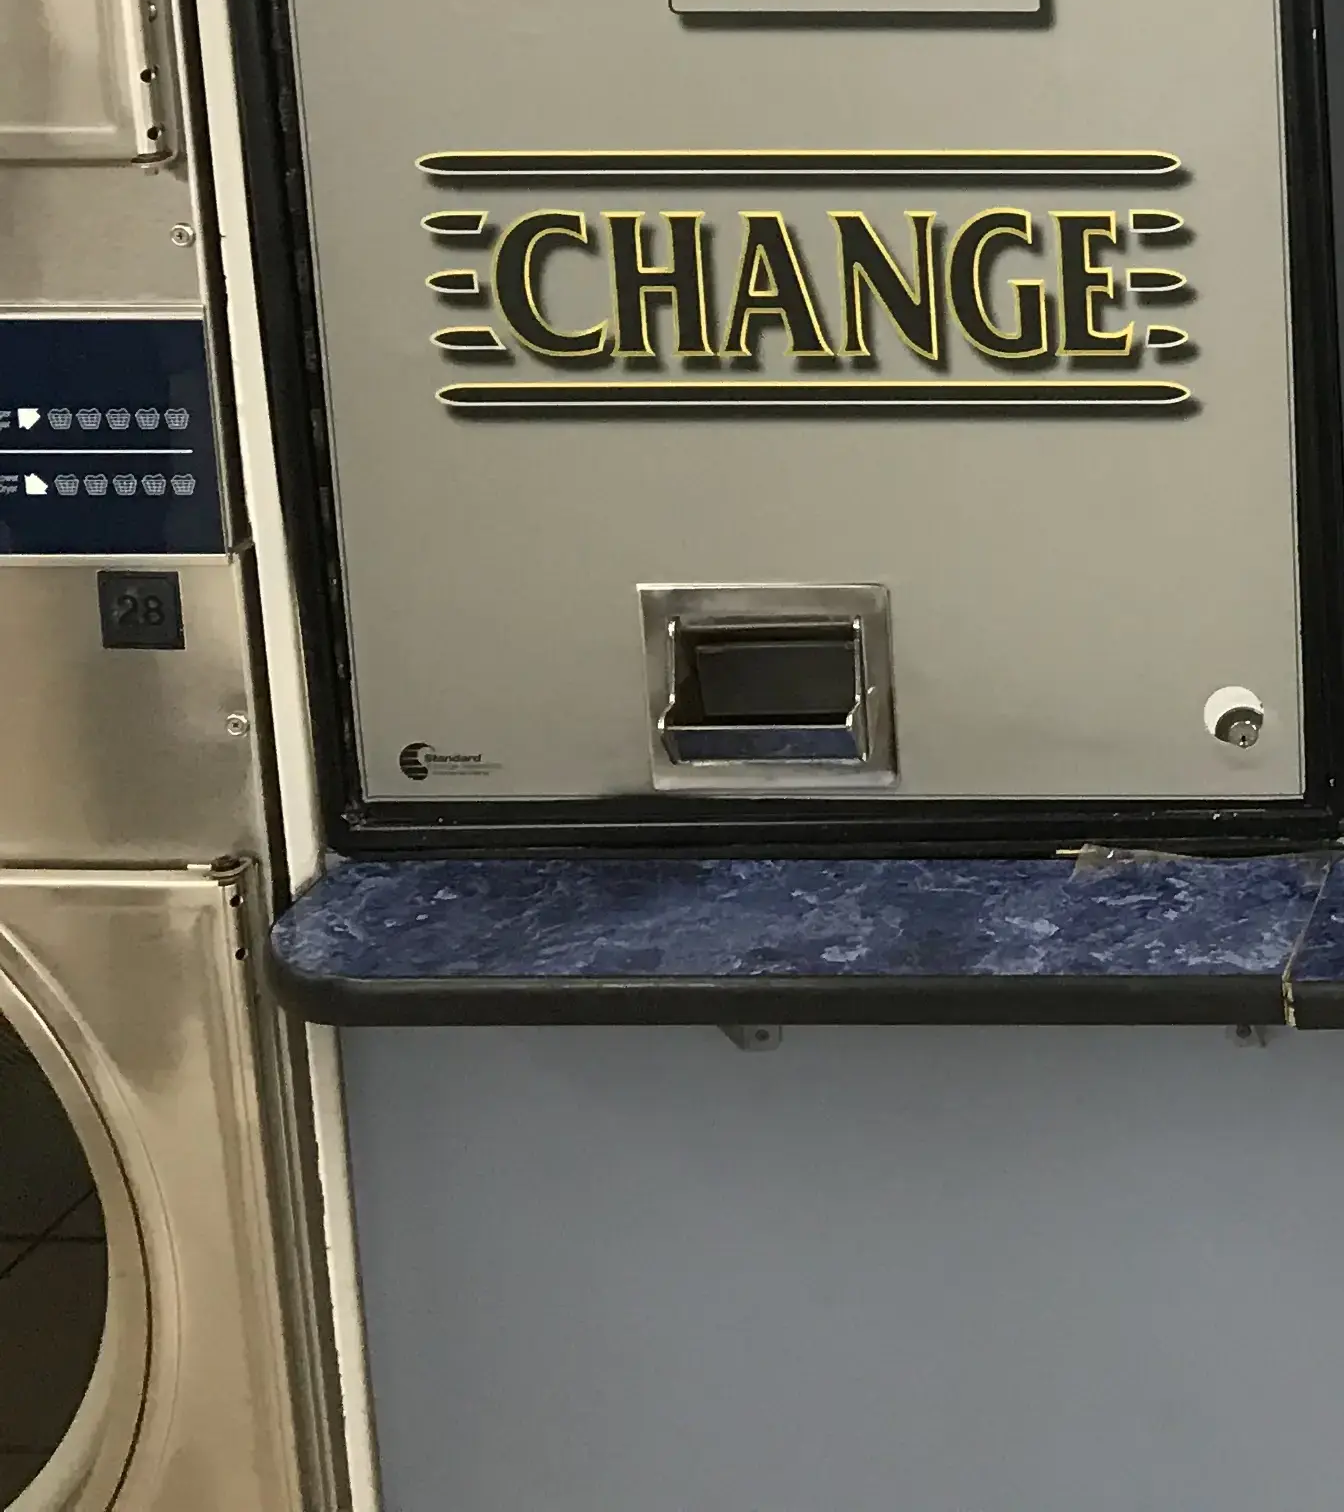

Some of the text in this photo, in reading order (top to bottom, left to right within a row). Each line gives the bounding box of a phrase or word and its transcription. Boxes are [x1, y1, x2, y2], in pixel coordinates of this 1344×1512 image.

[491, 207, 1135, 361] CHANGE
[117, 594, 166, 626] 28
[423, 753, 483, 763] Standard
